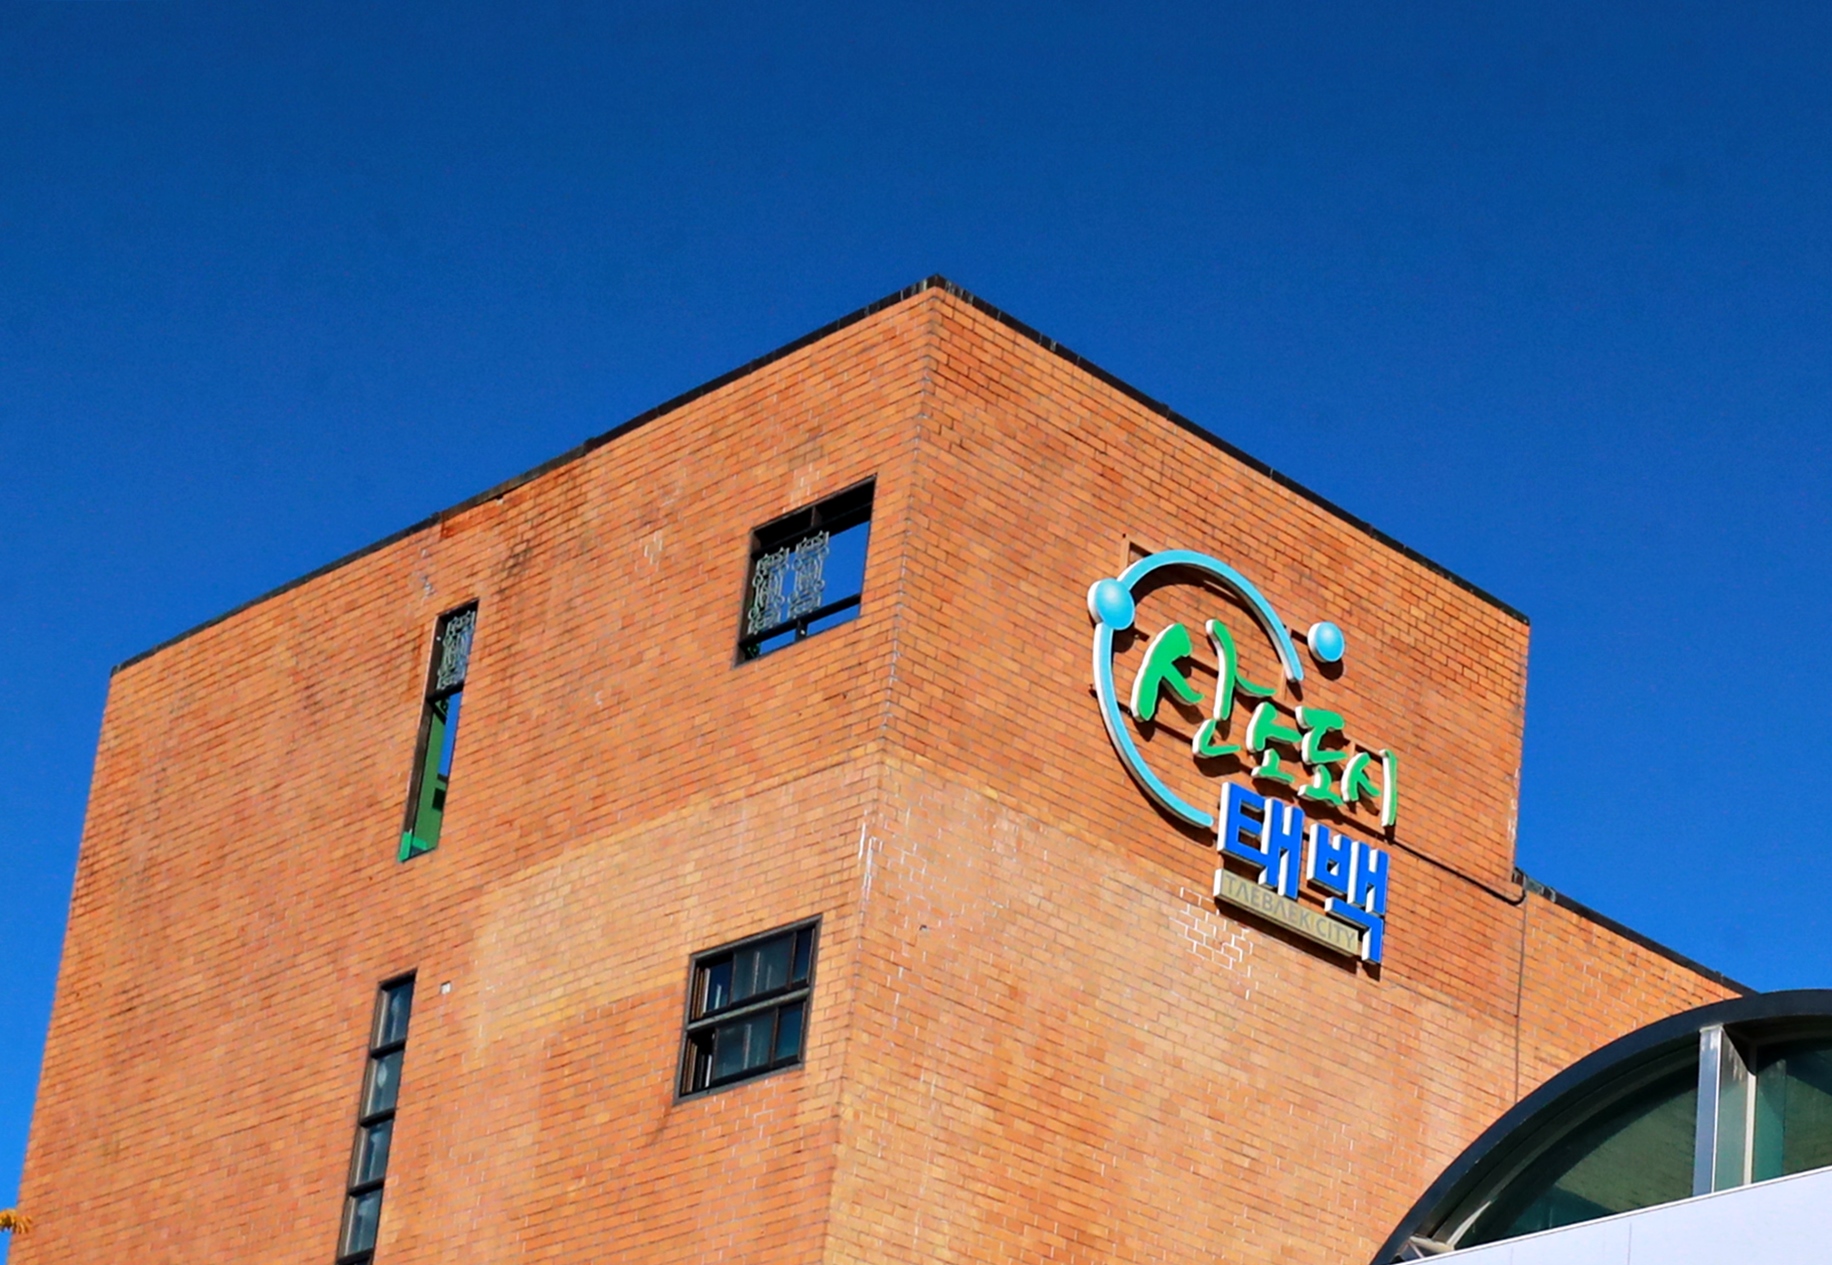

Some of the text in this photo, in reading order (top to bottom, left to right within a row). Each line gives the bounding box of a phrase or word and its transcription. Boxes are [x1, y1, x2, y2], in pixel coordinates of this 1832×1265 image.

[1130, 618, 1397, 827] 산소도시
[1217, 781, 1390, 964] 태백
[1225, 874, 1357, 946] TAEBAEK CITY
